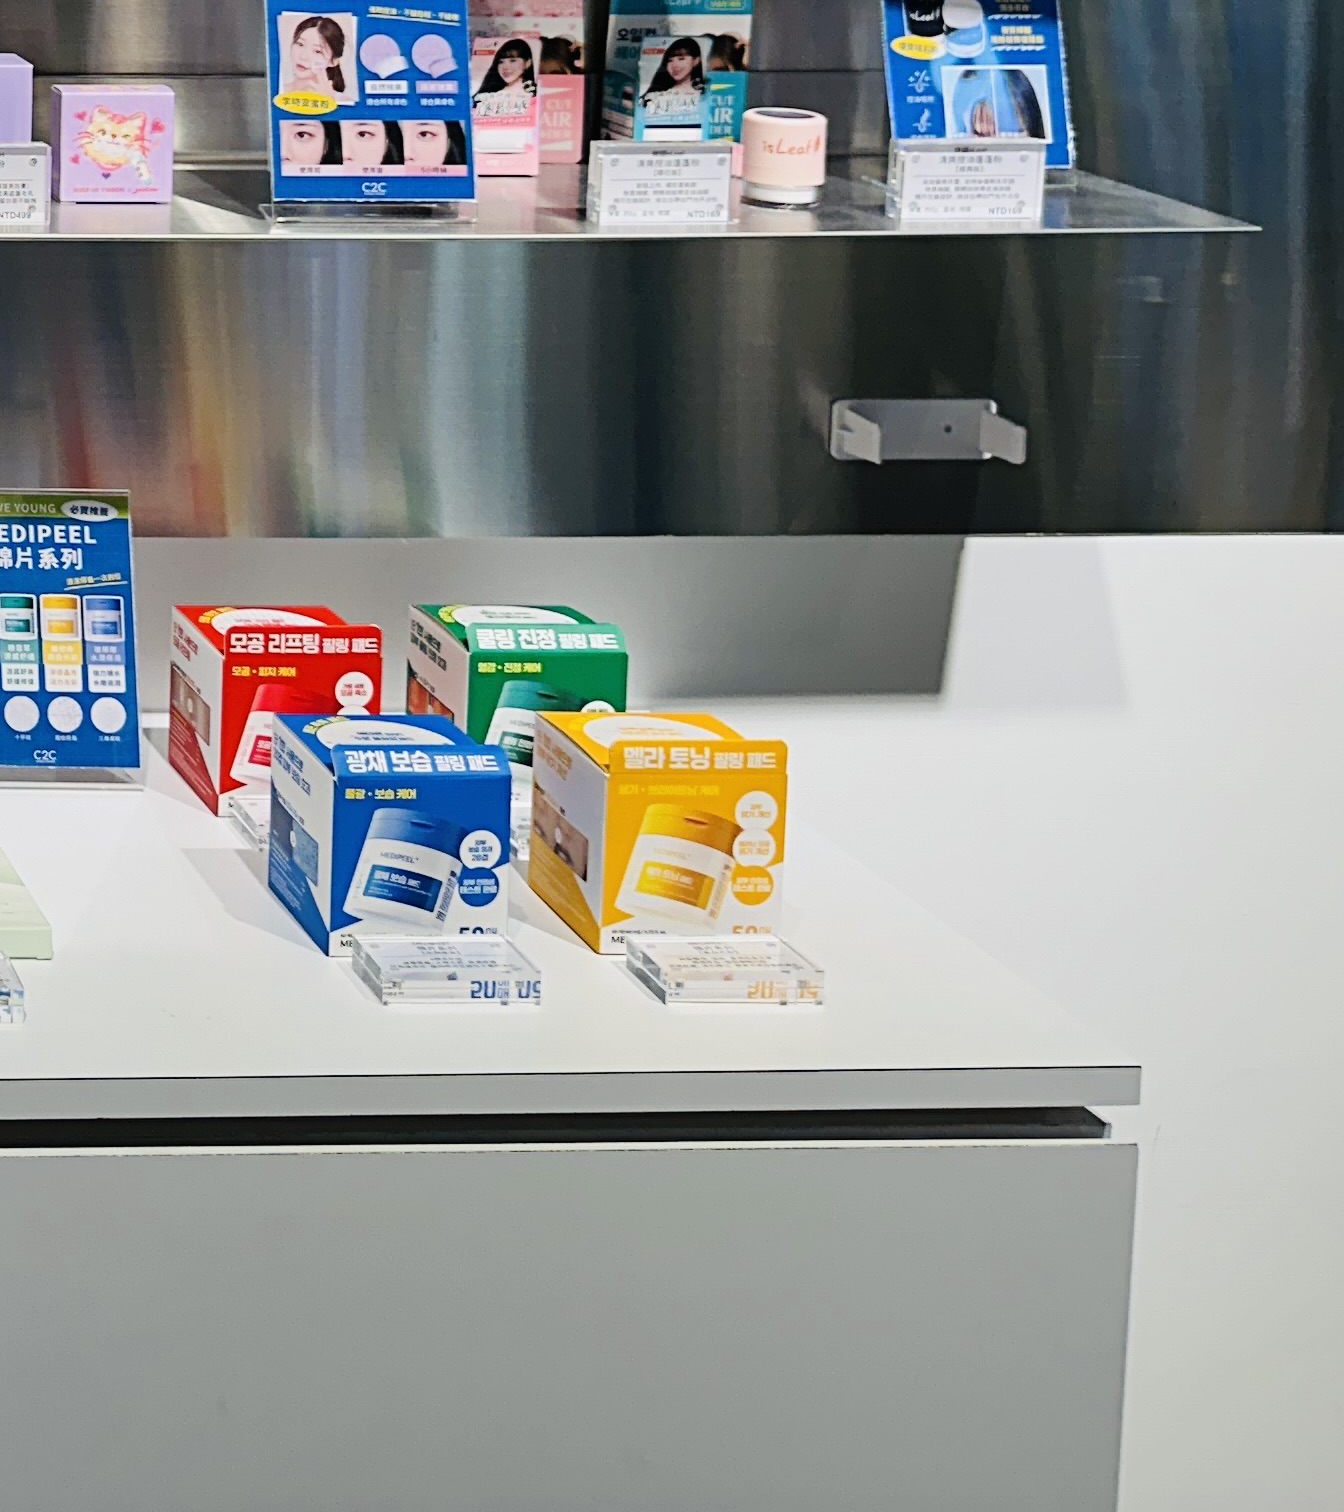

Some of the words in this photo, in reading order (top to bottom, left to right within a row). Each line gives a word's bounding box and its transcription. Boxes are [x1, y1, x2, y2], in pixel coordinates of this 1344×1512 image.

[362, 182, 387, 193] C2C
[14, 503, 56, 514] YOUNG
[229, 633, 265, 655] 모공
[268, 631, 321, 655] 리프팅
[322, 636, 349, 654] 필링
[351, 636, 379, 654] 패드
[476, 628, 515, 650] 쿨링
[520, 629, 555, 650] 진정
[558, 634, 586, 650] 필링
[588, 633, 618, 650] 패드
[33, 750, 57, 760] C2C
[344, 749, 389, 773] 광채
[391, 750, 433, 773] 보습
[434, 755, 466, 772] 필링
[467, 755, 500, 772] 패드
[623, 746, 665, 769] 멜라
[669, 745, 710, 769] 토닝
[714, 751, 744, 769] 필링
[746, 752, 776, 769] 패드
